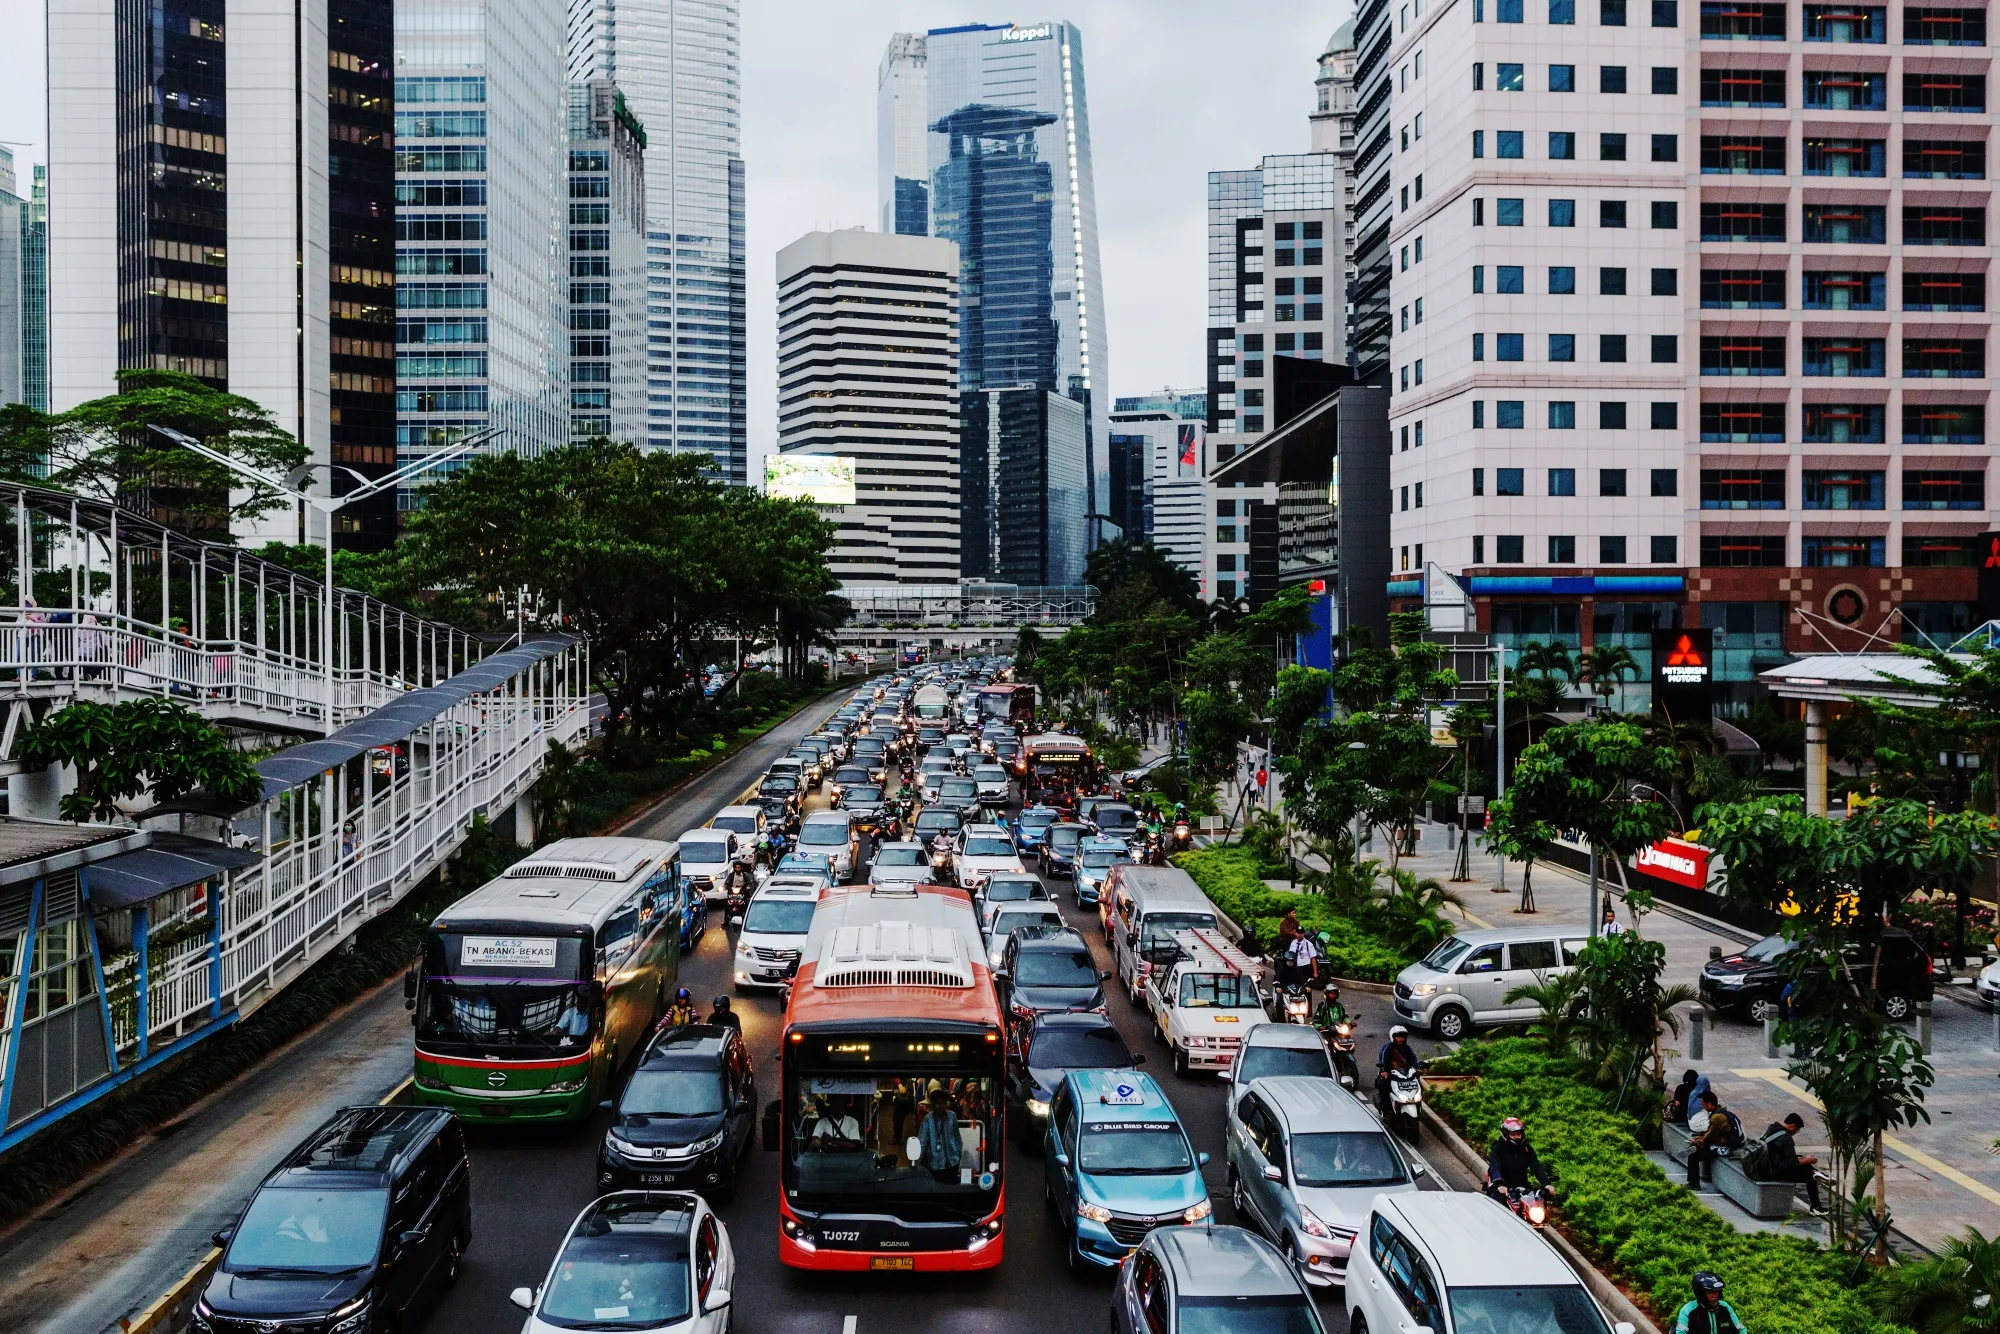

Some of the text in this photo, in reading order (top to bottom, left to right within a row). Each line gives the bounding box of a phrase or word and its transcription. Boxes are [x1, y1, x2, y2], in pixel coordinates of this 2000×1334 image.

[1002, 25, 1050, 41] Keppel
[1662, 666, 1708, 675] MITSUBISHI
[466, 946, 479, 955] TN
[822, 1230, 860, 1241] TJ0727
